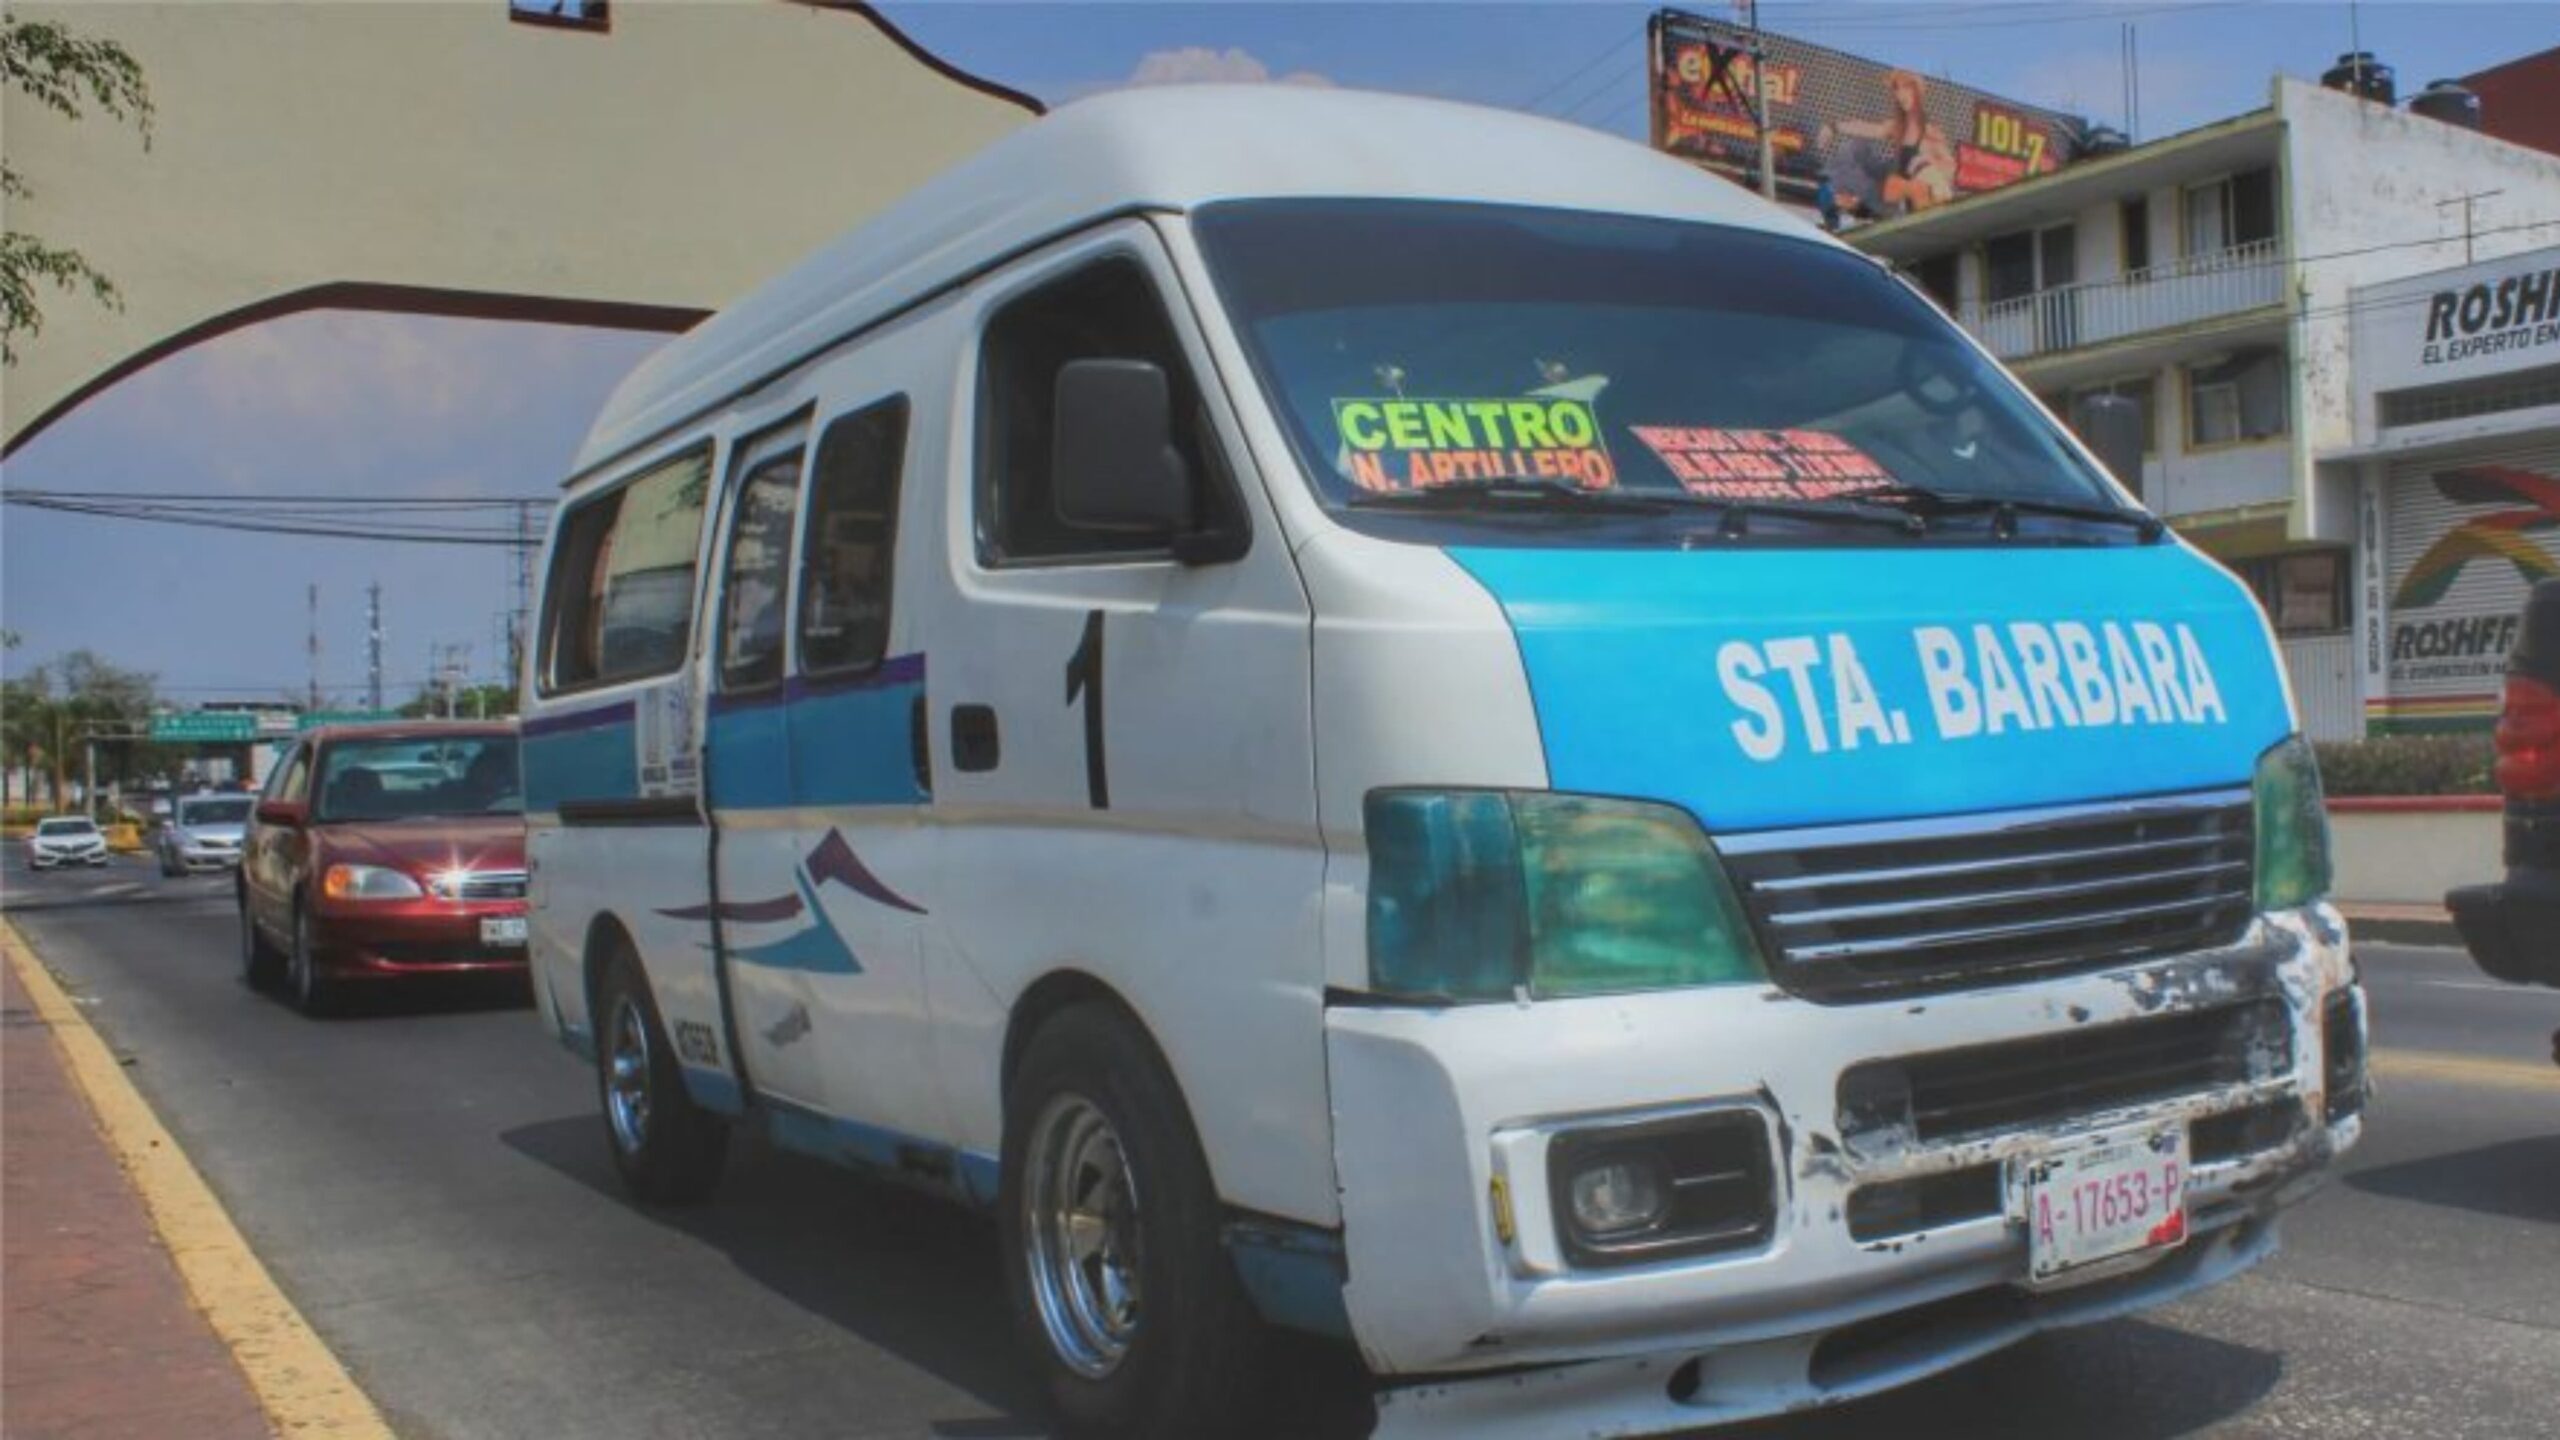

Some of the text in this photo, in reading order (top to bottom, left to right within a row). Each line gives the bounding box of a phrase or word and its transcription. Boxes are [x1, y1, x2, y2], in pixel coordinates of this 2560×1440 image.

[1980, 111, 2046, 176] 101.7
[2423, 345, 2443, 364] EL
[2447, 328, 2531, 361] EXPERTO
[1342, 401, 1594, 450] CENTRO
[1066, 609, 1109, 811] 1
[1716, 621, 2228, 761] STA. BARBARA
[2038, 1161, 2178, 1244] A-17653-P
